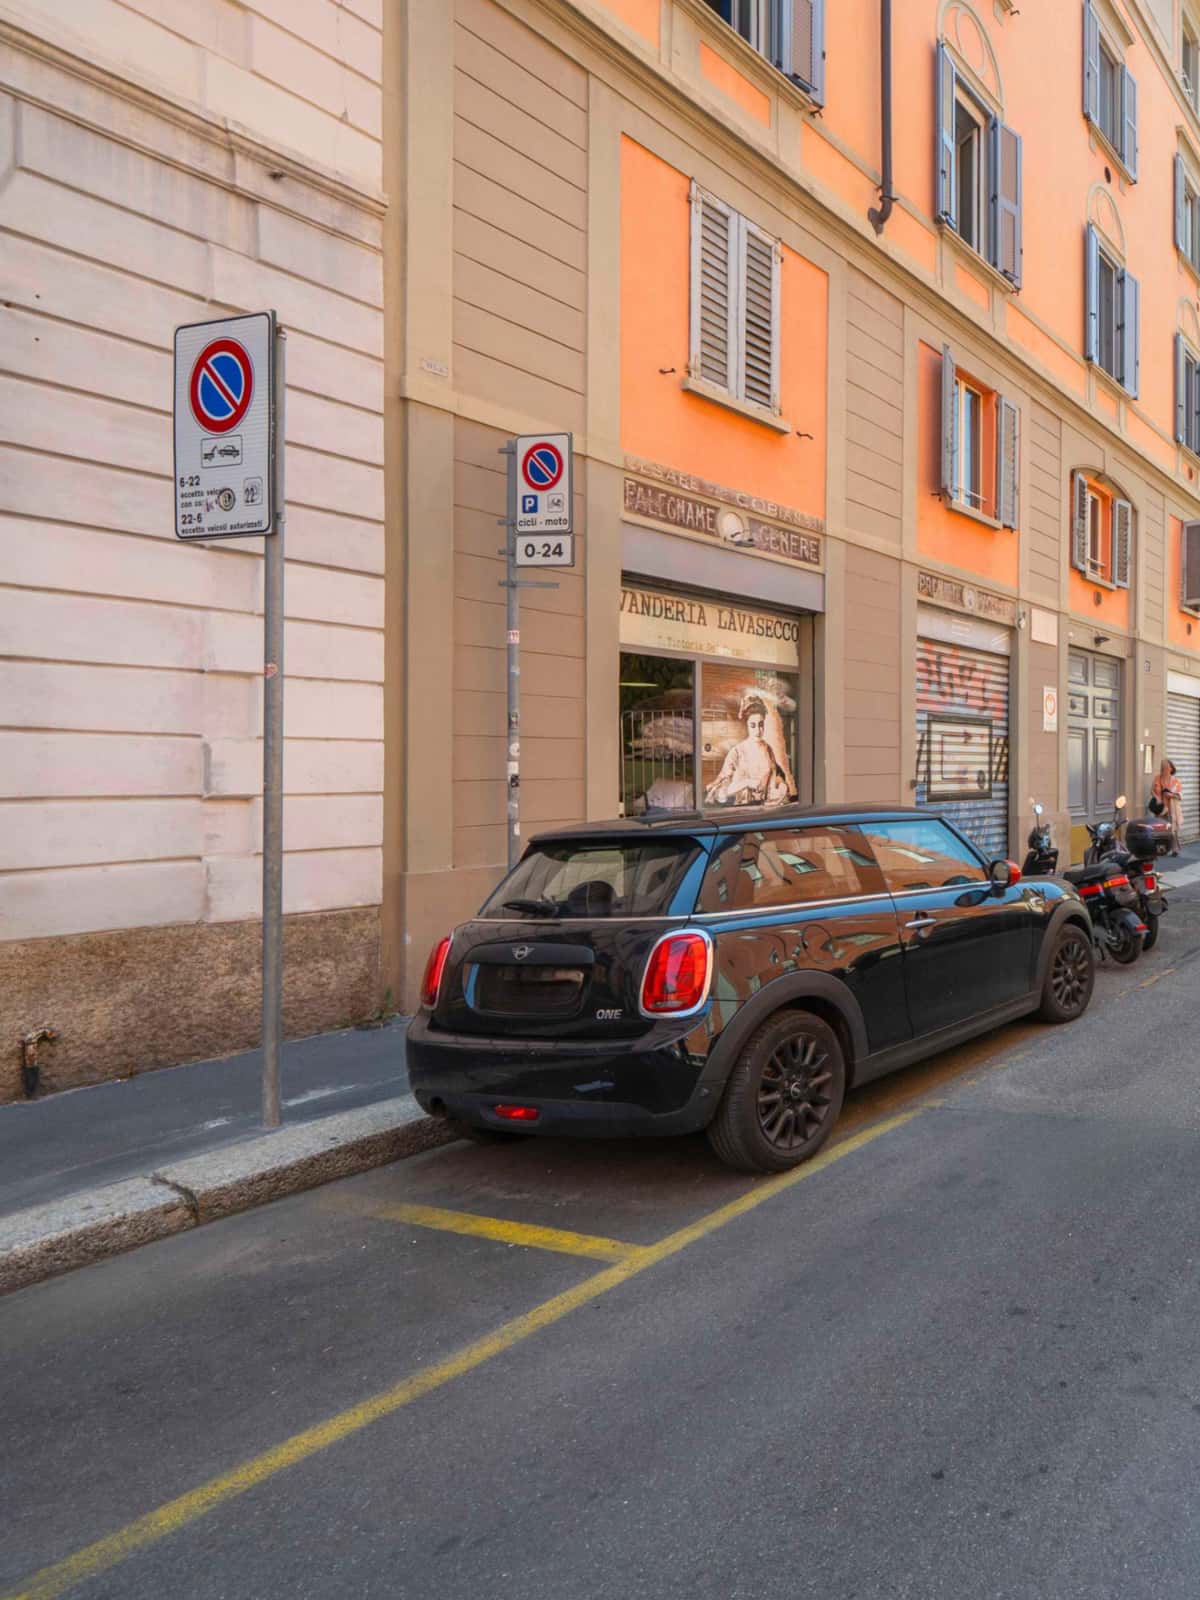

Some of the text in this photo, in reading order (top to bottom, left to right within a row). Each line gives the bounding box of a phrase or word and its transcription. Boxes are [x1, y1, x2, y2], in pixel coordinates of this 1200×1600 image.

[180, 475, 201, 487] 6-22
[525, 497, 535, 512] P
[181, 513, 203, 525] 22-6
[519, 518, 537, 527] cicli
[545, 517, 568, 526] moto
[524, 543, 563, 558] 0-24
[717, 607, 800, 642] LAVASECCO
[596, 1008, 624, 1020] ONE
